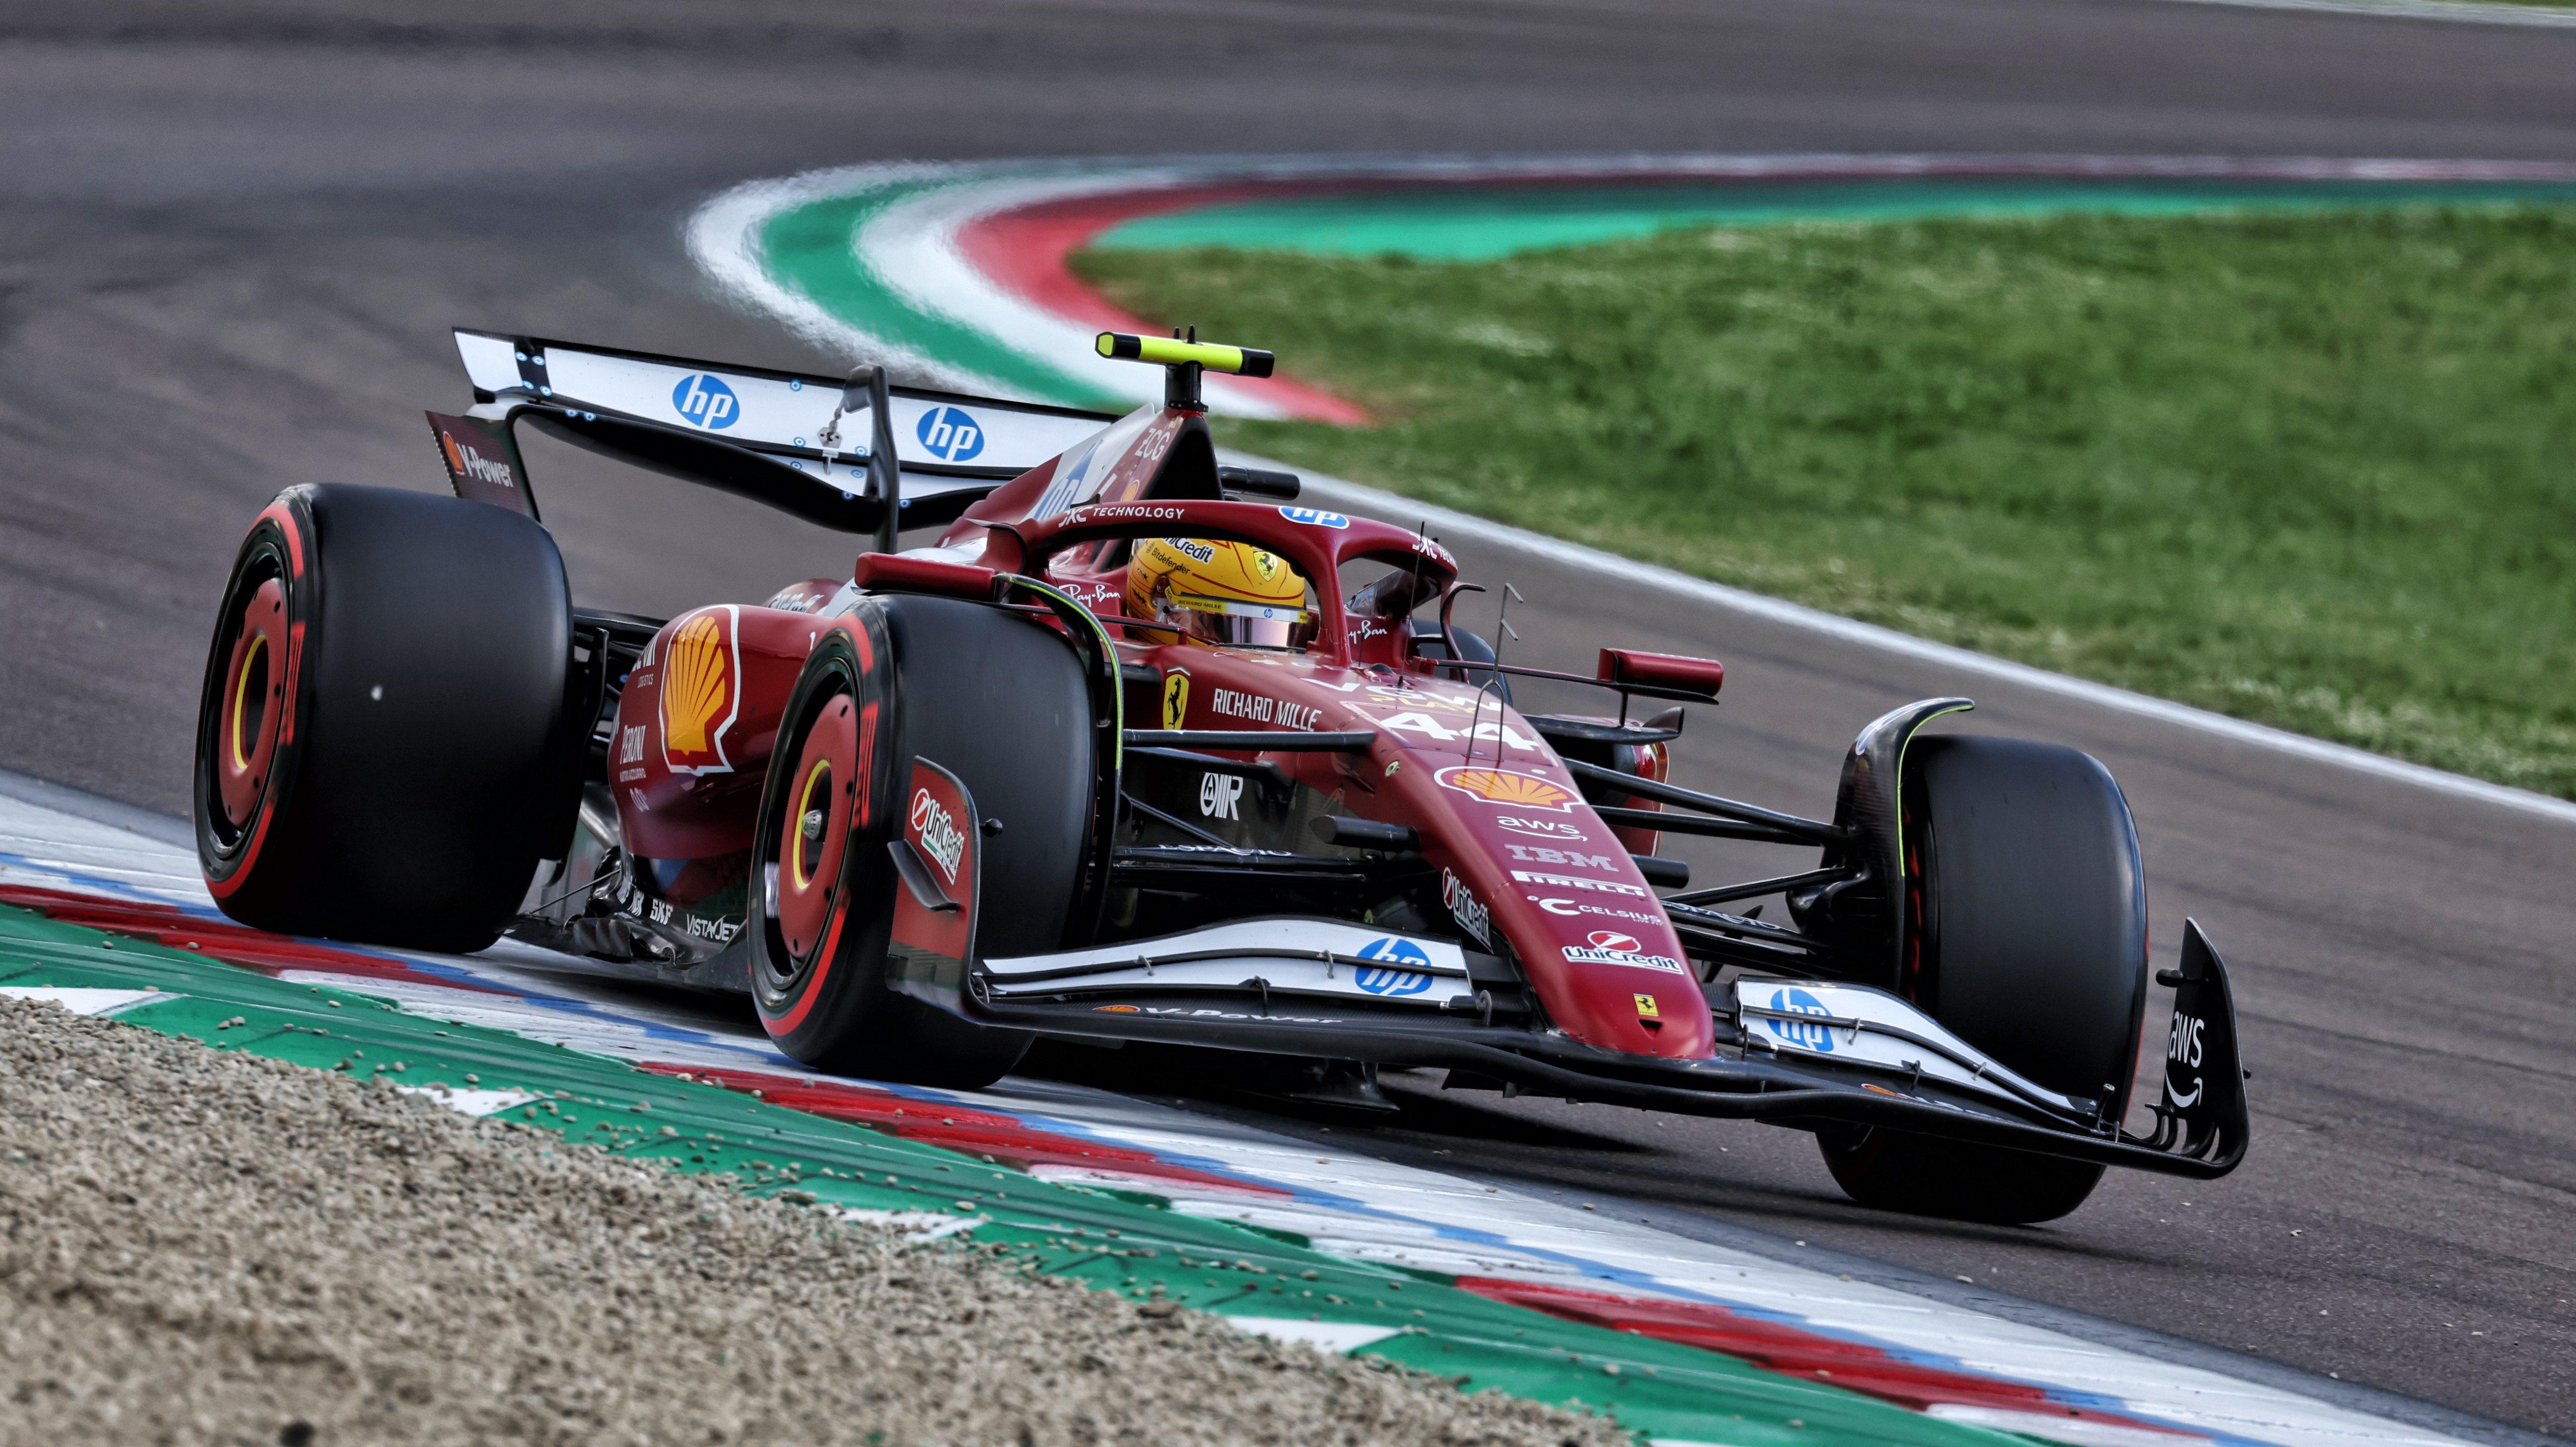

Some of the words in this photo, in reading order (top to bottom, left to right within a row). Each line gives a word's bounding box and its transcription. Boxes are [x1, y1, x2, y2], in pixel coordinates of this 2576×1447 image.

[678, 374, 734, 429] hp
[922, 407, 981, 462] hp
[1135, 428, 1170, 461] ZCG
[456, 442, 514, 487] V-Power
[1093, 506, 1184, 520] TECHNOLOGY
[1151, 547, 1190, 575] Bitdefender
[1264, 608, 1273, 618] hp
[1212, 688, 1273, 723] RICHARD
[1274, 701, 1323, 732] MILLE
[620, 724, 646, 765] PERONI
[1380, 712, 1544, 751] 44
[926, 802, 963, 871] UniCredit
[1496, 816, 1580, 836] aws
[1504, 844, 1620, 872] IBM
[1510, 870, 1646, 897] PIRELLI
[649, 898, 673, 925] SKF
[686, 913, 740, 942] VISTAJET
[1453, 878, 1490, 944] UniCredit
[1578, 905, 1662, 923] CELSIUS
[1359, 938, 1429, 995] hp
[1563, 945, 1681, 971] UniCredit
[1145, 1007, 1343, 1024] V-Power
[1771, 986, 1832, 1052] hp
[2168, 1010, 2205, 1068] aws
